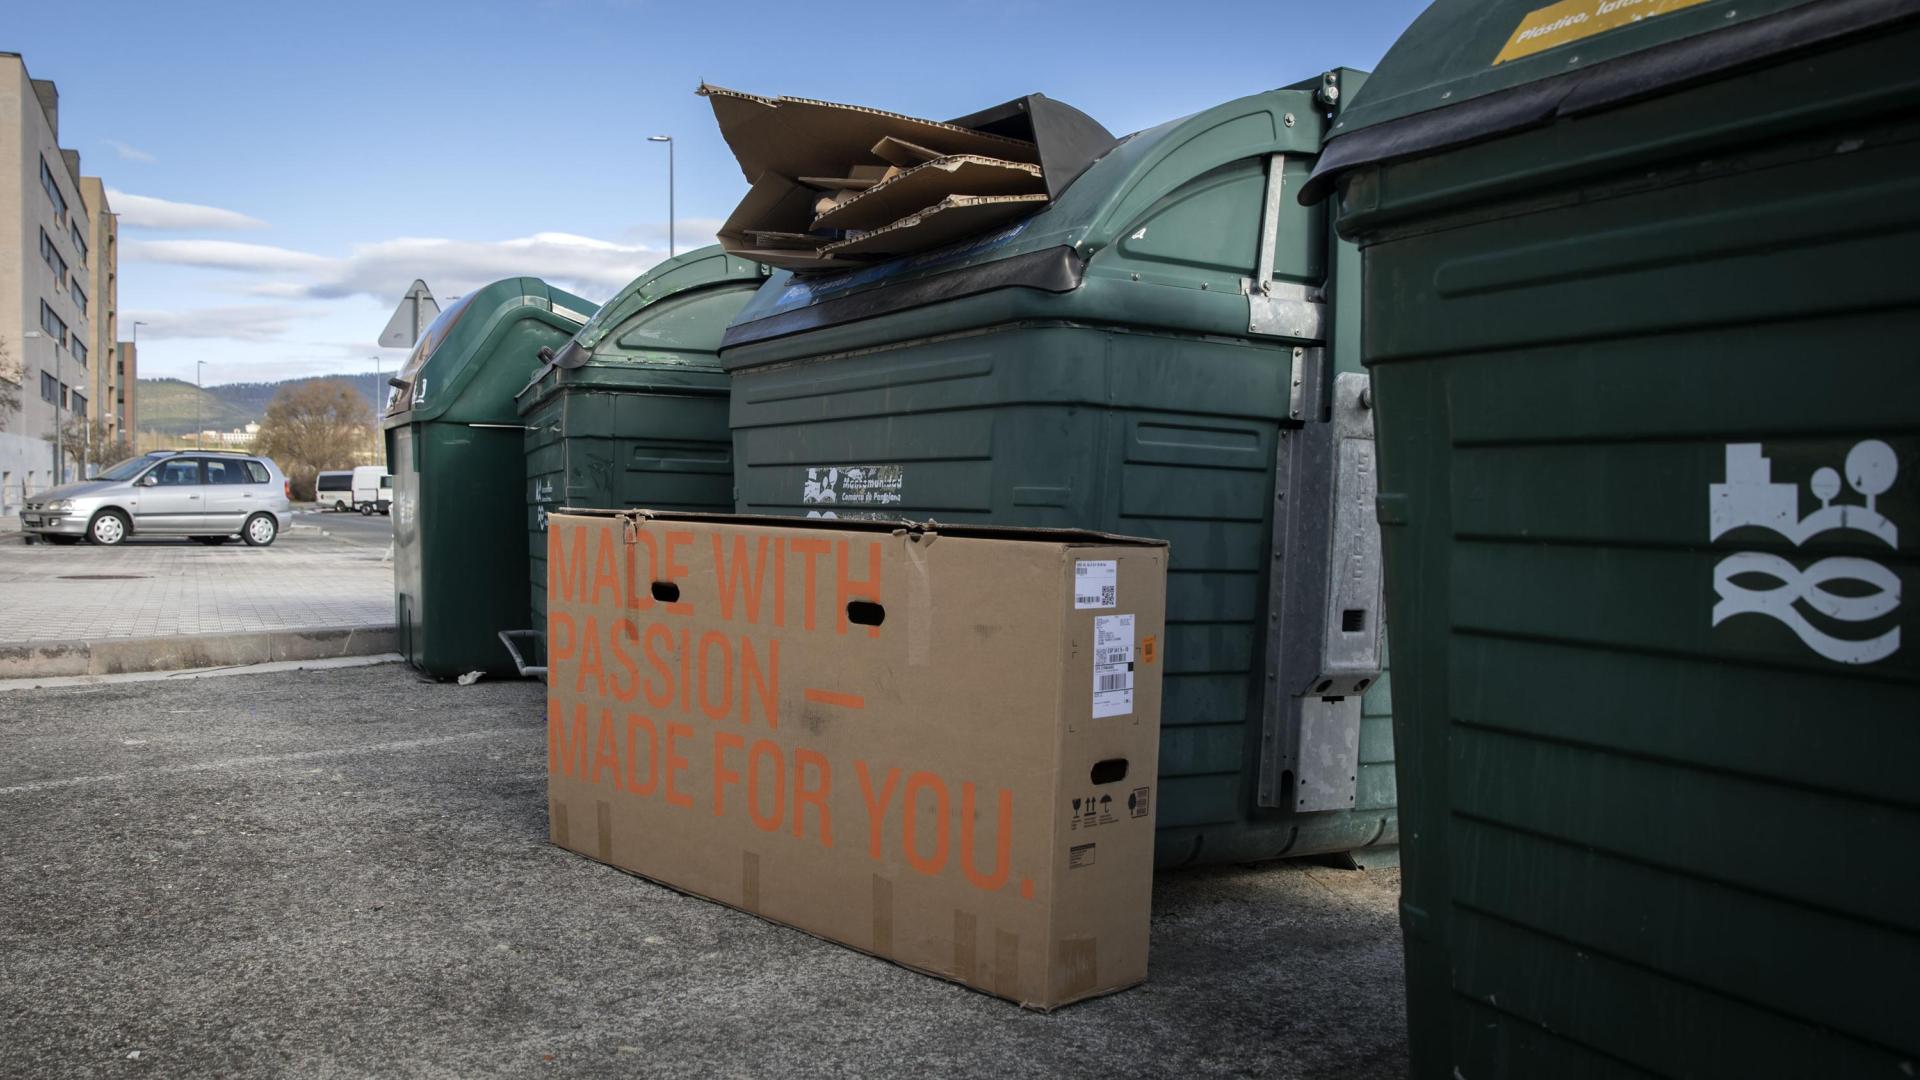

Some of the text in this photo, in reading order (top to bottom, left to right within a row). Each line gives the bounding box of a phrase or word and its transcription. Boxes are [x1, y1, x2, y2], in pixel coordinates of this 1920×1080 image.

[548, 524, 882, 639] MADE WITH
[549, 611, 780, 729] PASSION
[548, 696, 1035, 899] MADE FOR YOU.
